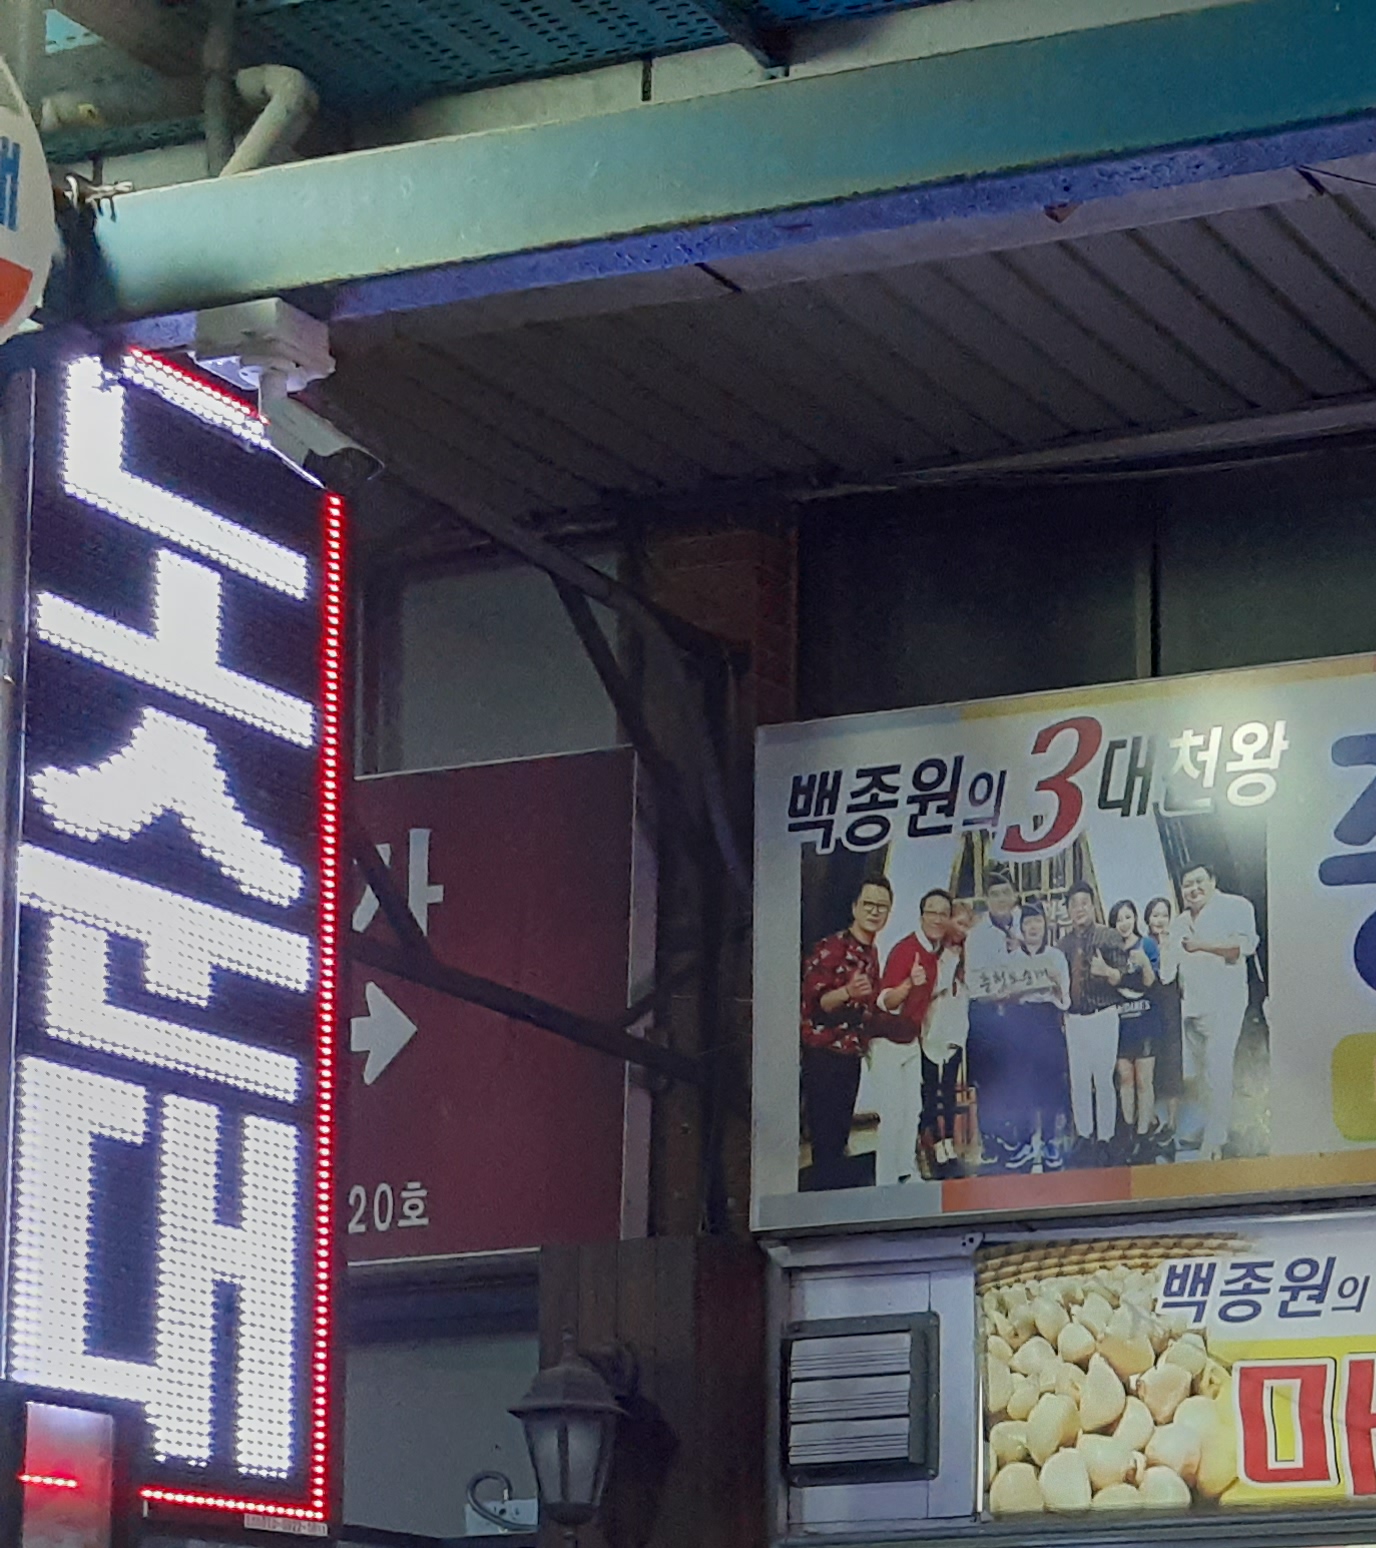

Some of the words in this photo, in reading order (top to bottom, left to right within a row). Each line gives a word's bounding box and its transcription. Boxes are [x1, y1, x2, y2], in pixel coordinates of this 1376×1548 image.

[787, 755, 1008, 855] 백종원의
[1000, 715, 1289, 854] 3대천왕
[1160, 1256, 1371, 1325] 백종원의
